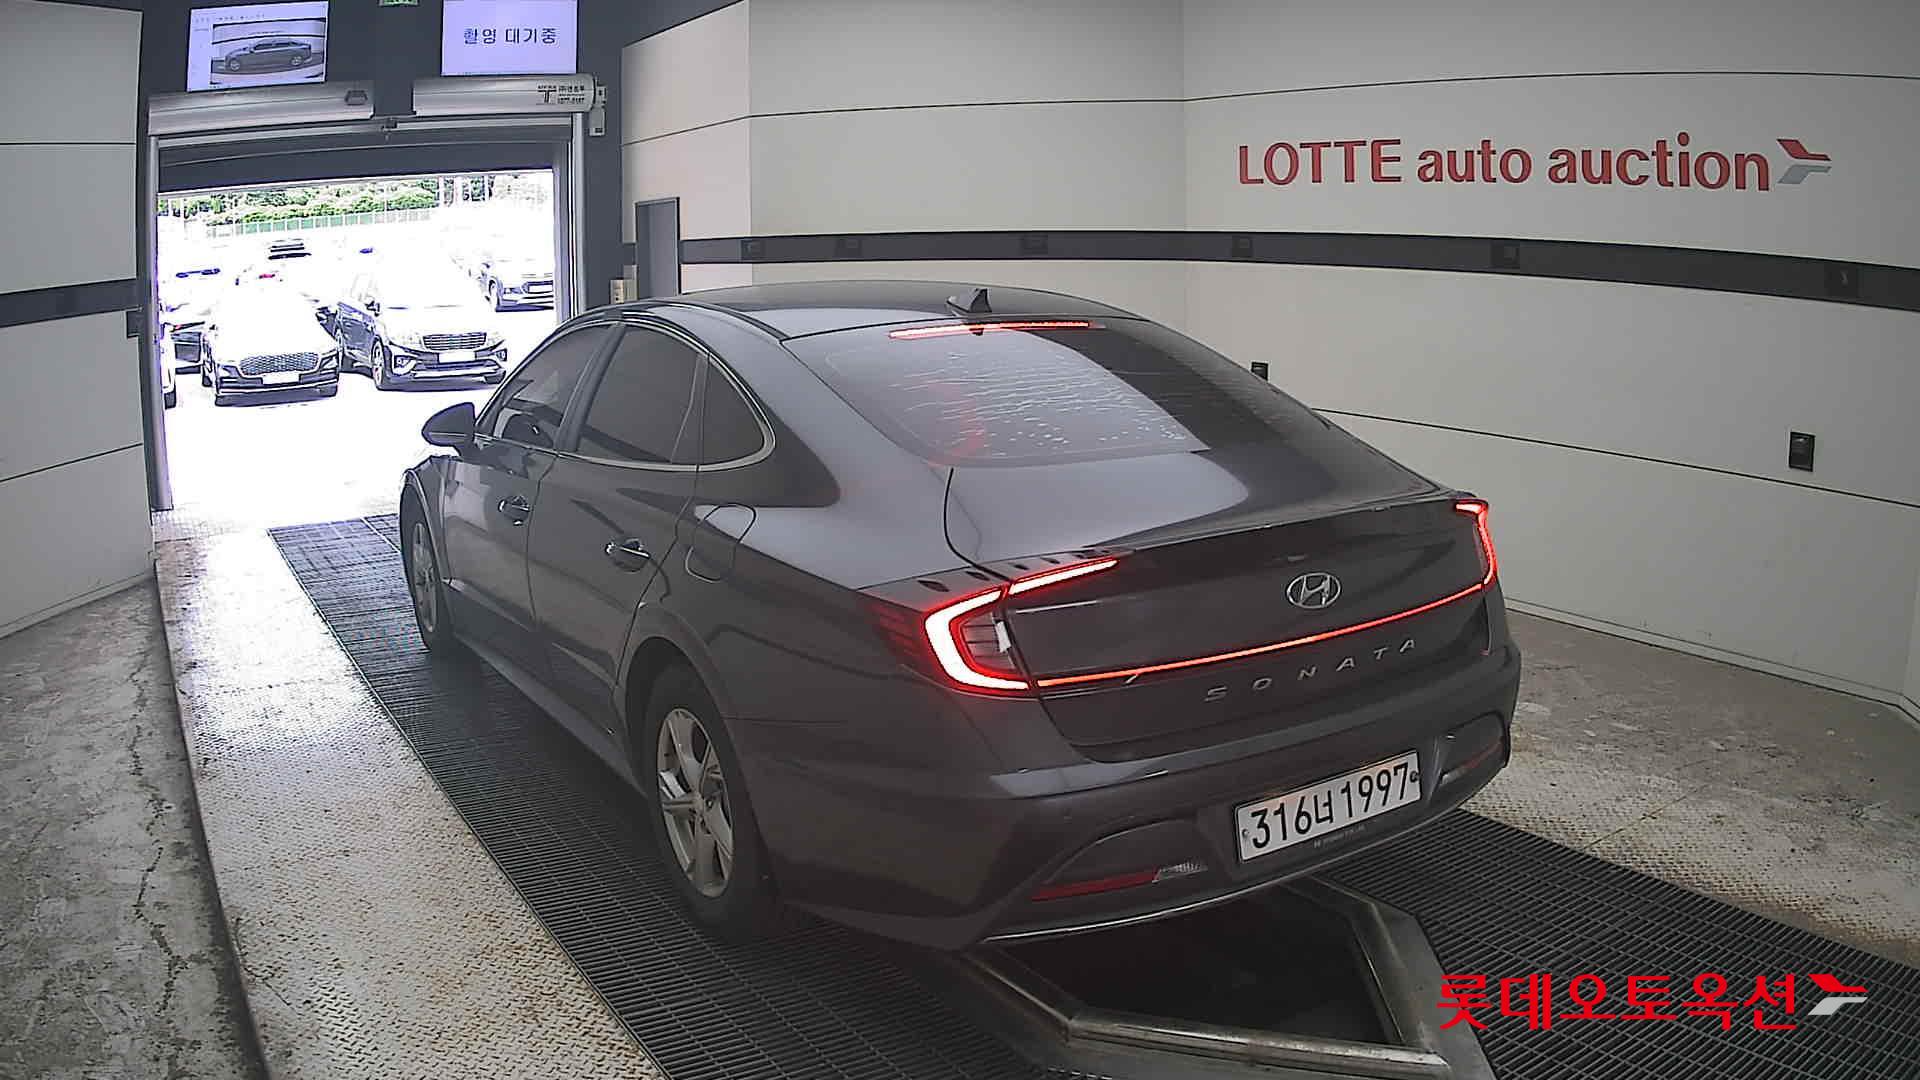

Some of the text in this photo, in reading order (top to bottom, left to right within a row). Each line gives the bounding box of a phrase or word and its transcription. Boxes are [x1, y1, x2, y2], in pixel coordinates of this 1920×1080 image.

[505, 28, 557, 44] 대기중
[1238, 131, 1770, 192] LOTTE auto auction
[1204, 639, 1416, 701] SONATA
